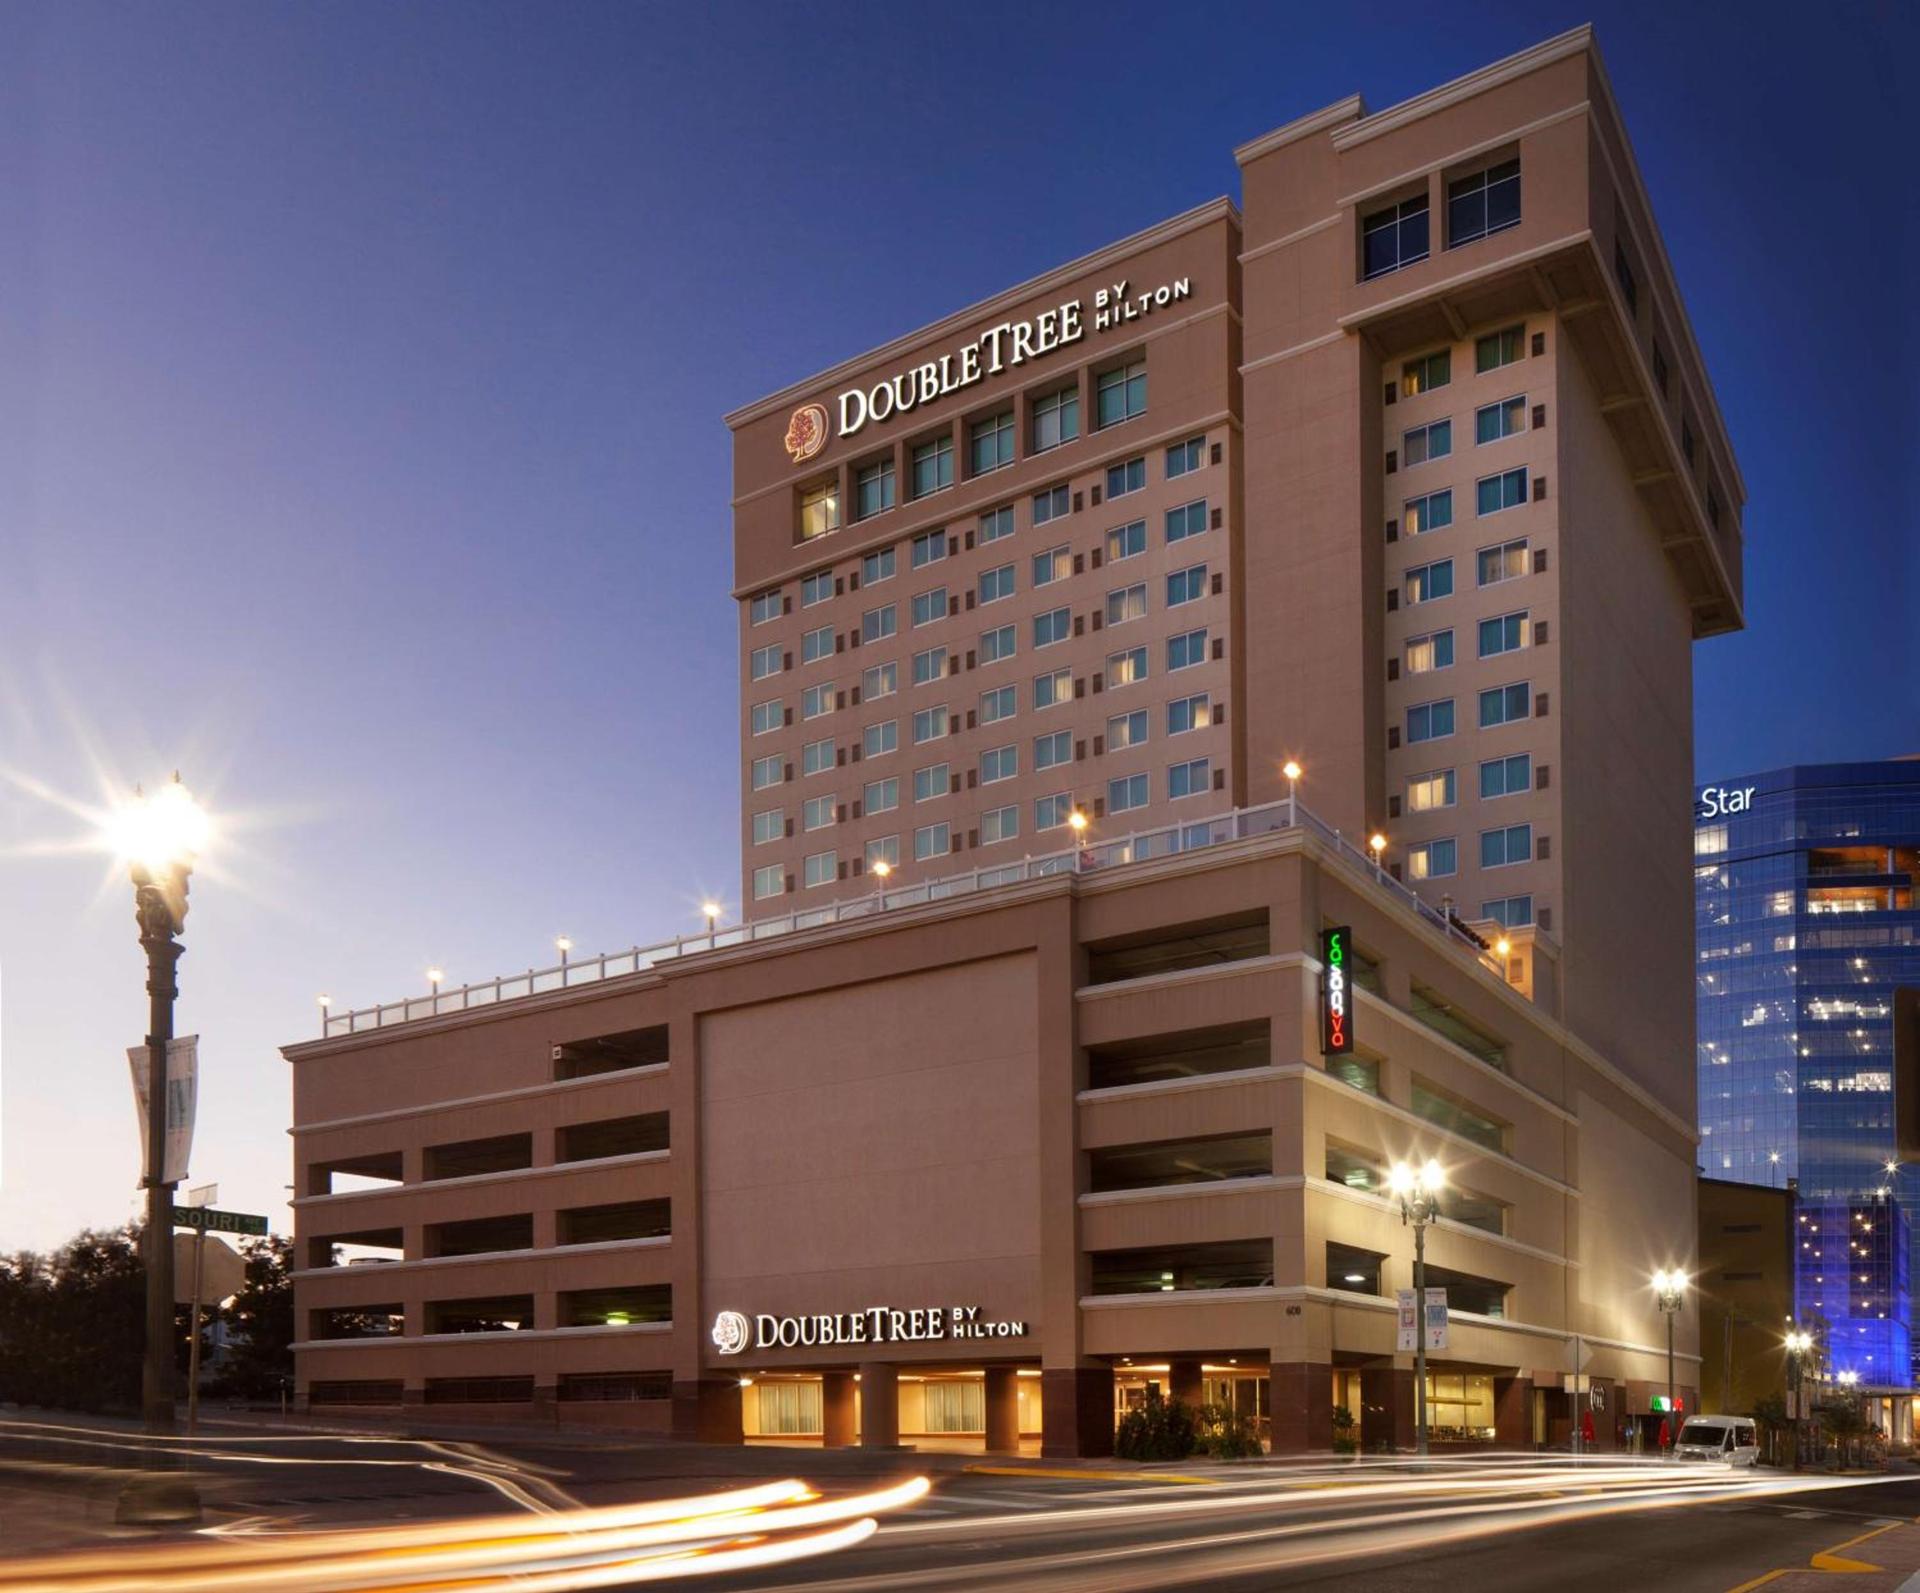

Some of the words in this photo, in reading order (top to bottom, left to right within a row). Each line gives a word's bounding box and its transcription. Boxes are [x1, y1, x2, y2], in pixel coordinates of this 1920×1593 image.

[1096, 281, 1127, 308] BY
[1096, 278, 1190, 329] HILTON
[838, 300, 1082, 437] DOUBLETREE
[1702, 787, 1755, 818] Star
[174, 1208, 239, 1231] SOURI
[756, 1308, 944, 1347] DOUBLETREE
[953, 1307, 977, 1320] BY
[953, 1322, 1023, 1339] HILTON
